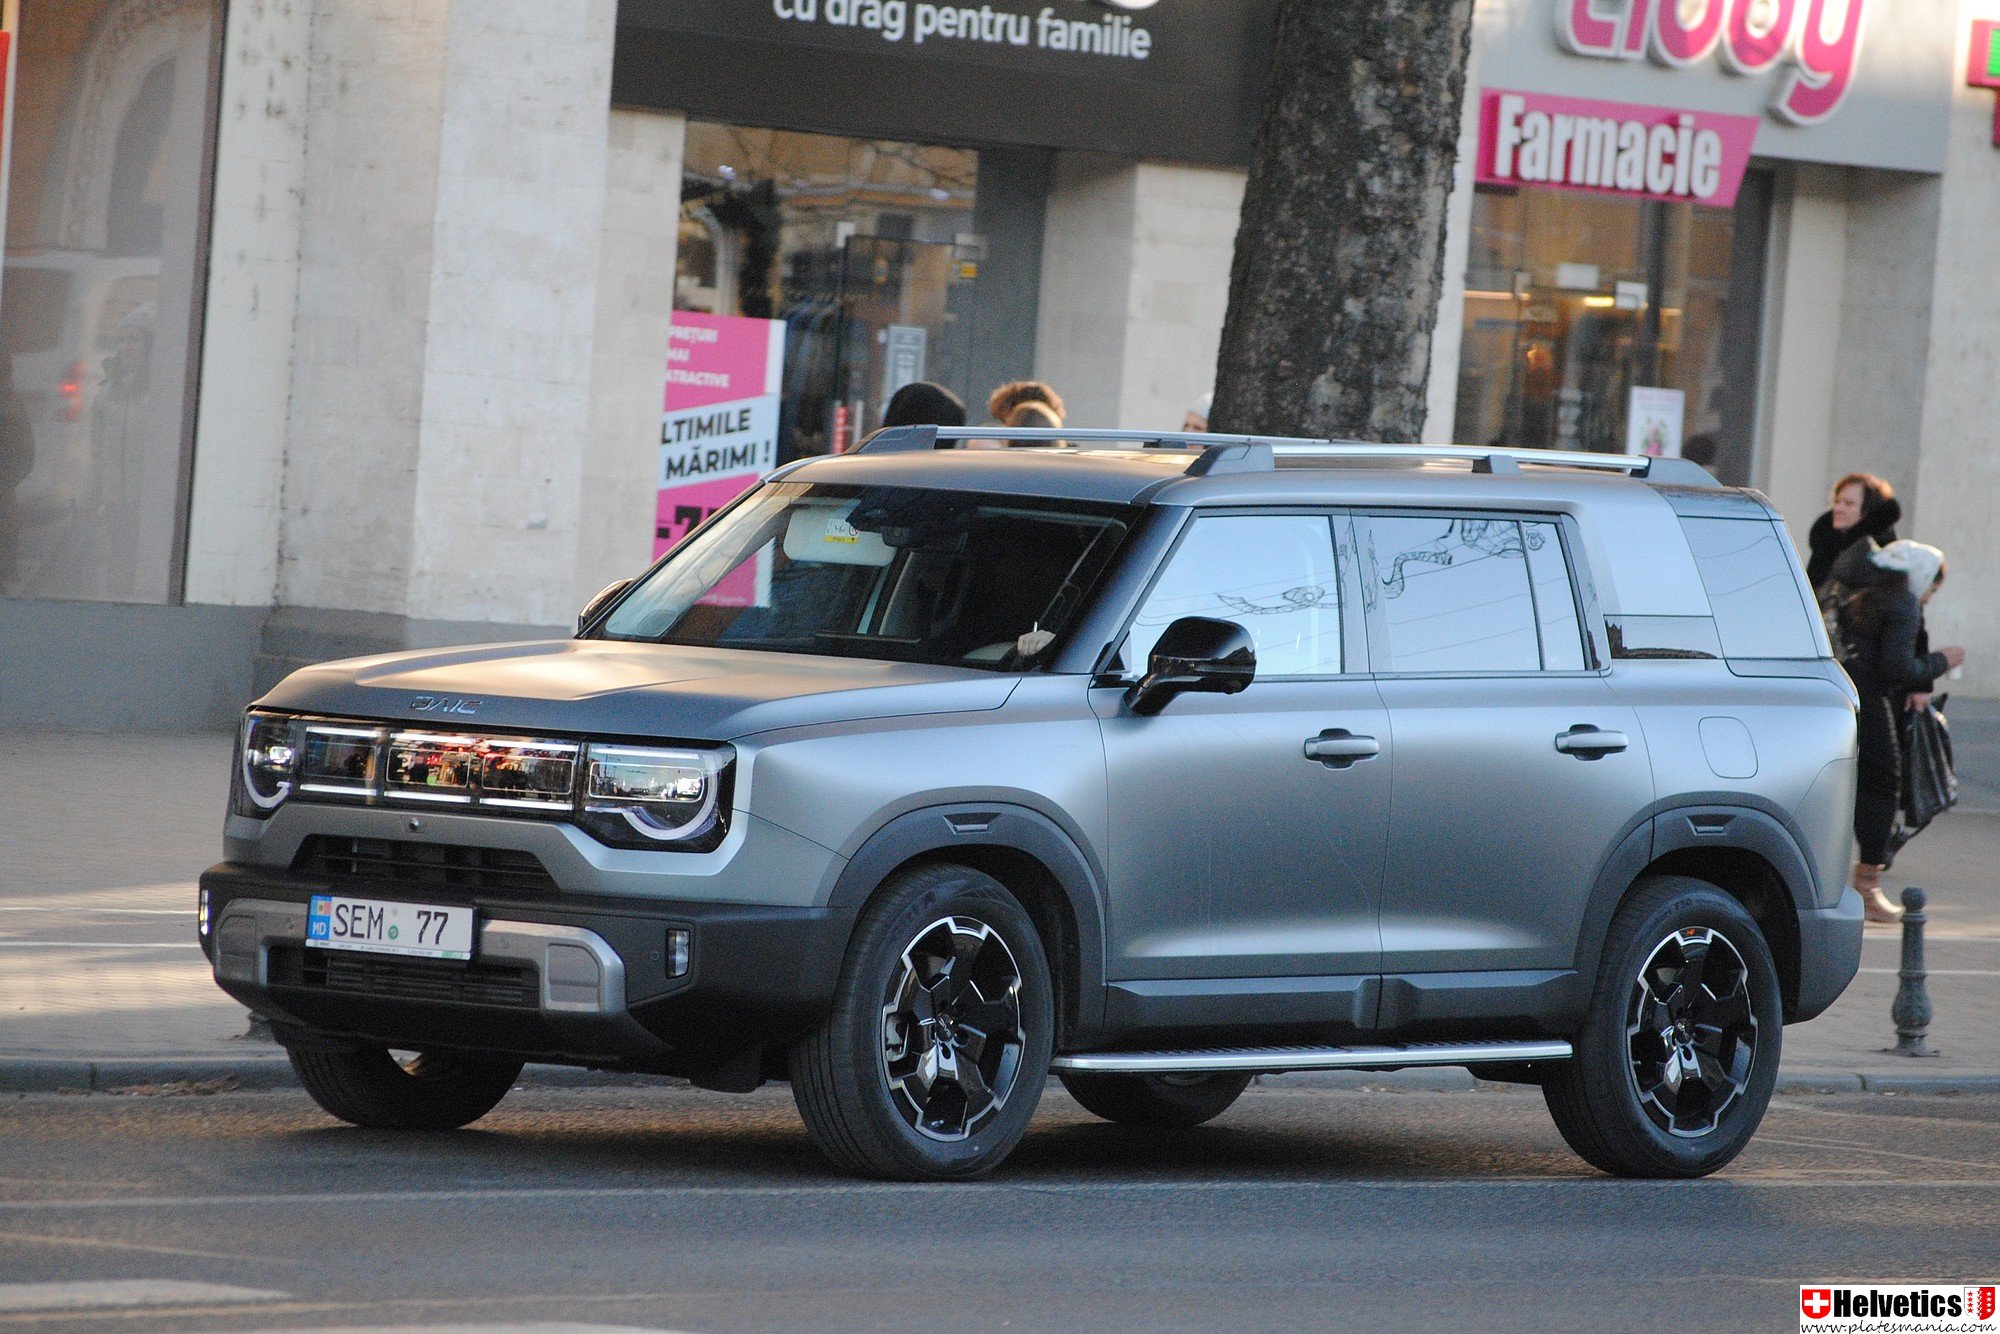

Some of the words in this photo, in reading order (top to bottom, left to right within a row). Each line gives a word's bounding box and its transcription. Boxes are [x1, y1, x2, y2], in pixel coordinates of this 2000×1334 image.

[824, 0, 907, 42] drag
[913, 3, 1030, 45] pentru
[1037, 7, 1152, 60] familie
[1494, 94, 1722, 198] Farmacie
[666, 442, 756, 480] MĂRIMI
[409, 696, 482, 715] BAIC
[312, 920, 327, 936] MD
[333, 903, 384, 940] SEM
[417, 910, 449, 945] 77
